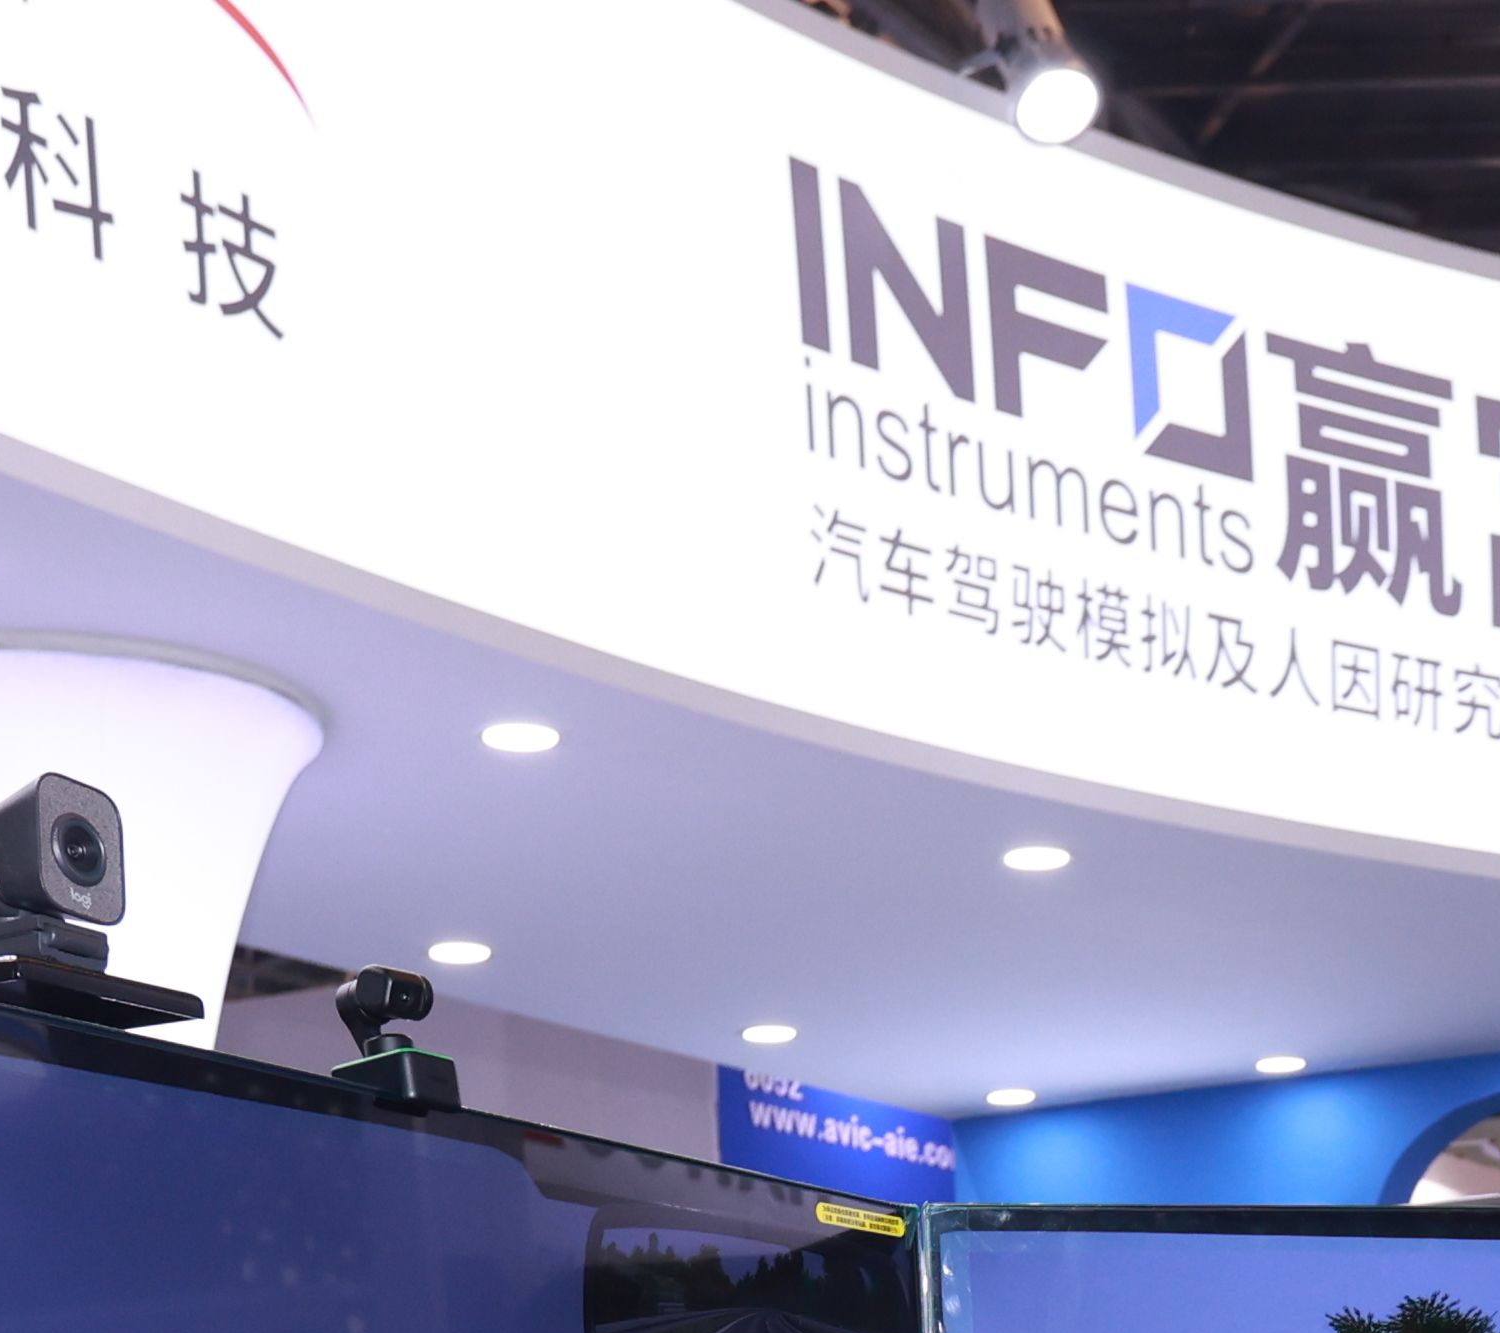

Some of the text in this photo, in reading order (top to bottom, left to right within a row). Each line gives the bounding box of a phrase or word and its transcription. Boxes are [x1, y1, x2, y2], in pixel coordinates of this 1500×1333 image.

[788, 154, 1254, 484] INFO
[803, 355, 1254, 578] instruments
[69, 887, 92, 910] logi
